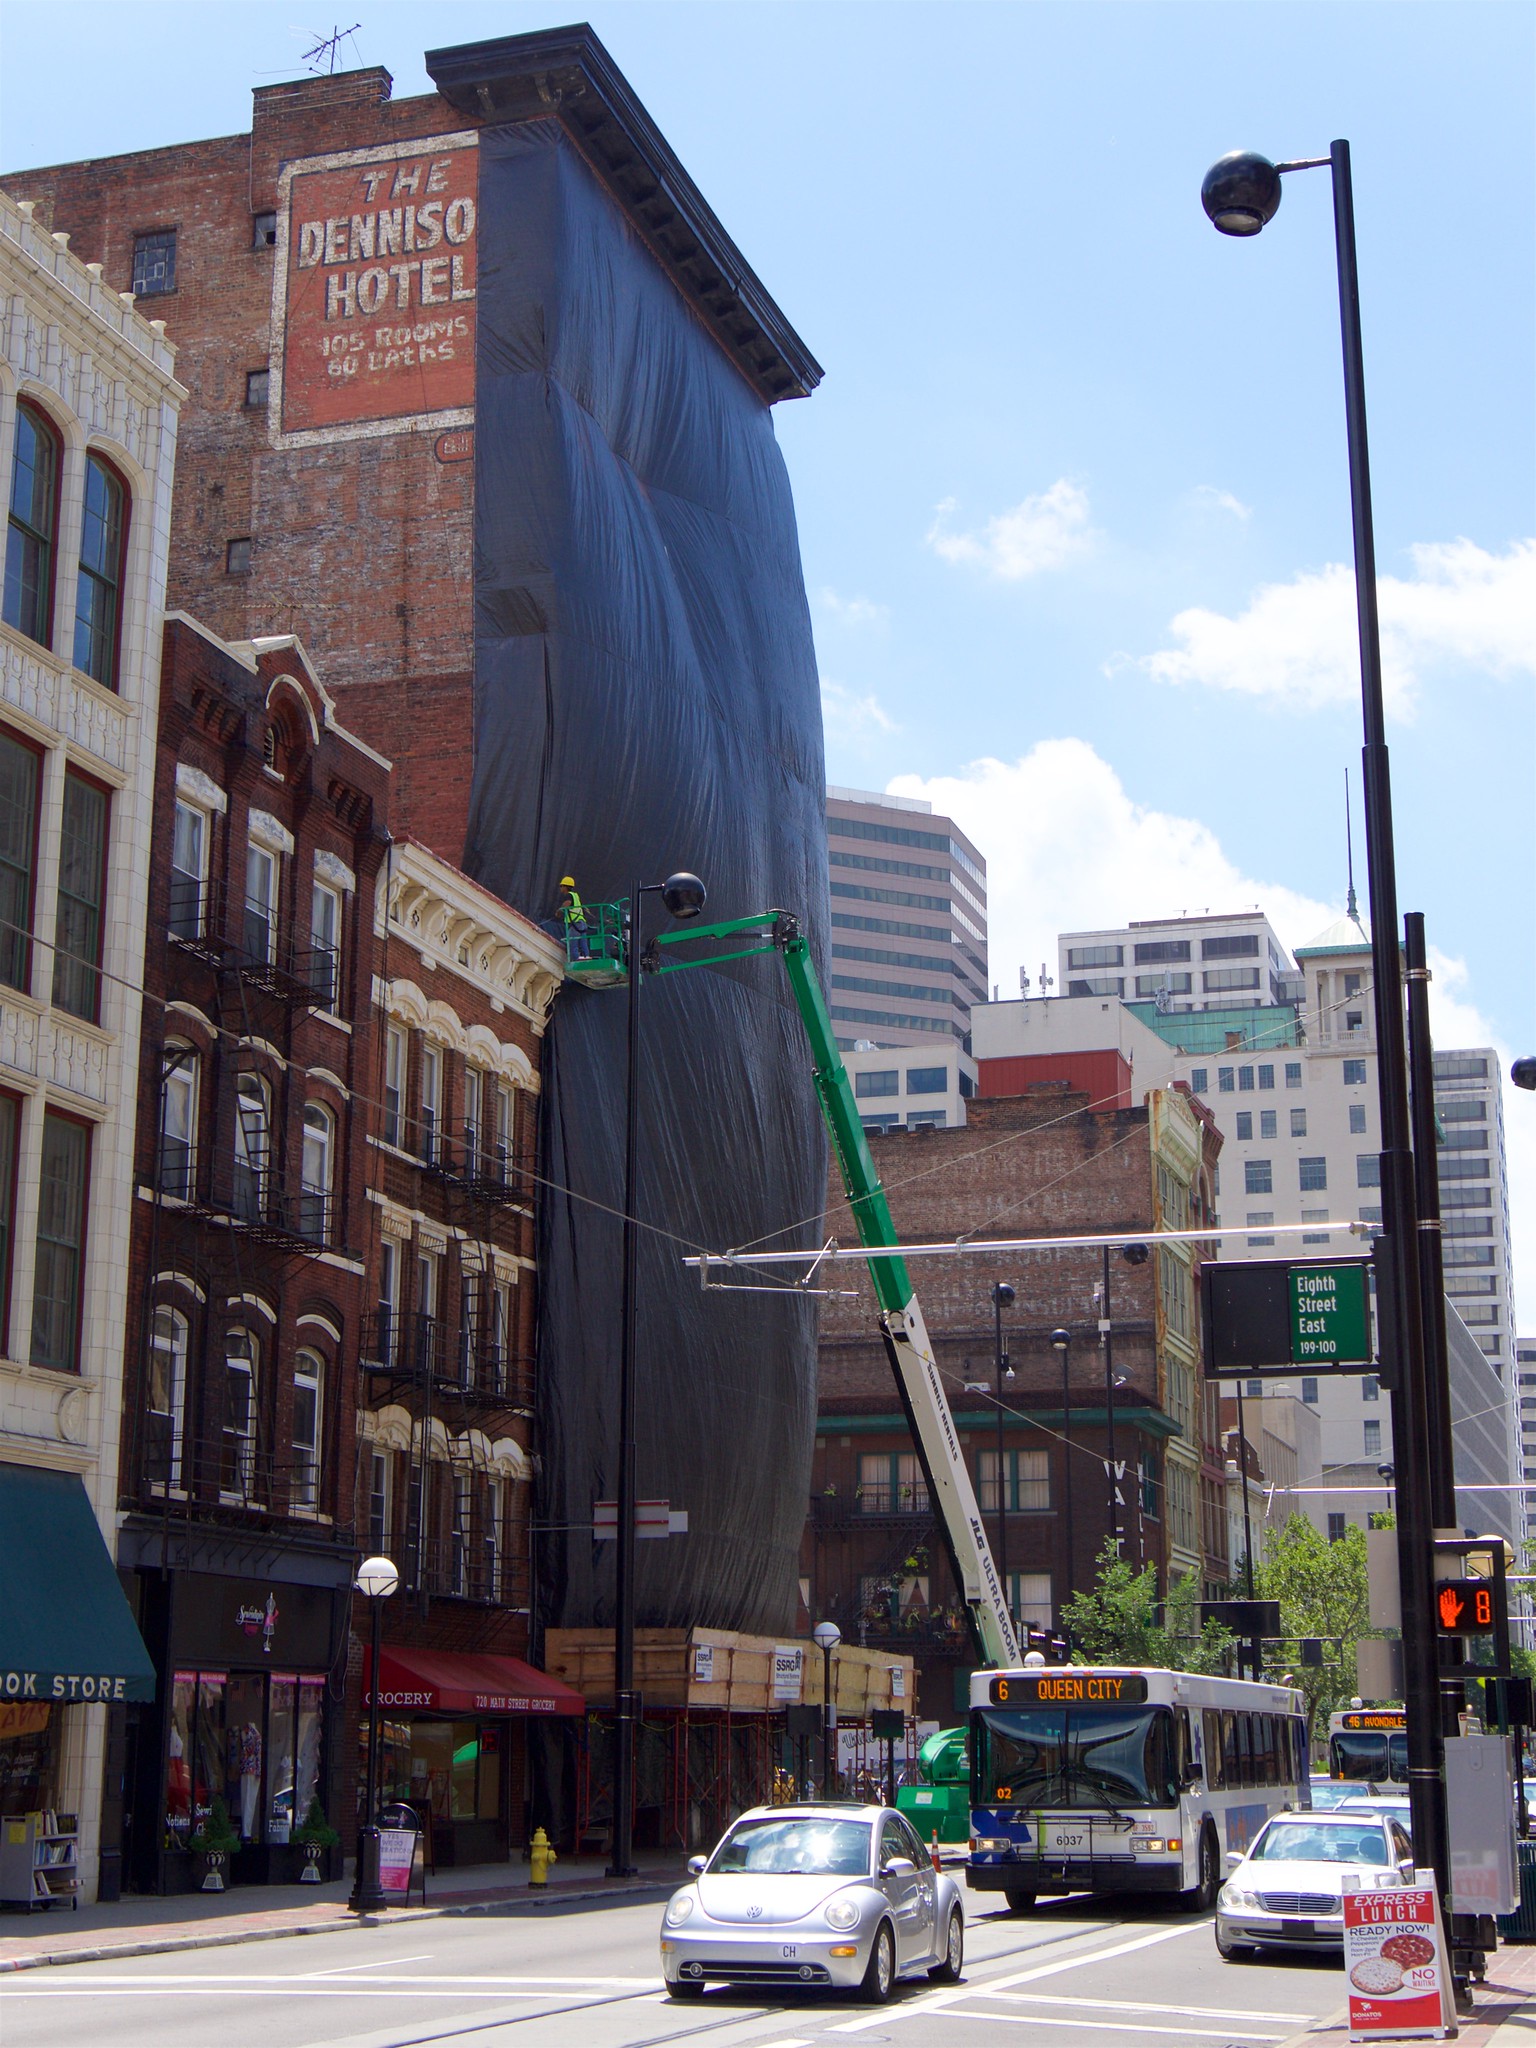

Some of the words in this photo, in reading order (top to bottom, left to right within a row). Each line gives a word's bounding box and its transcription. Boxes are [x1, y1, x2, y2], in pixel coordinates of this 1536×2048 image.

[361, 158, 452, 203] THE
[325, 255, 477, 321] HOTEL
[319, 331, 365, 356] 105
[375, 315, 469, 348] ROOMS
[1297, 1275, 1336, 1296] Eighth
[1298, 1296, 1337, 1313] Street
[1299, 1317, 1326, 1334] East
[1300, 1340, 1336, 1354] 199-100
[941, 1412, 958, 1461] RENTALS
[970, 1518, 985, 1550] JLG
[983, 1556, 1001, 1609] ULTRA
[998, 1610, 1017, 1661] BOOM
[776, 1659, 795, 1671] SSRG
[0, 1672, 37, 1696] OK
[52, 1675, 126, 1699] STORE
[998, 1680, 1009, 1700] 6
[1038, 1680, 1083, 1700] QUEEN
[1087, 1679, 1123, 1700] CITY
[475, 1695, 488, 1708] 720
[489, 1696, 506, 1709] MAIN
[508, 1697, 530, 1710] STREET
[531, 1699, 556, 1711] GROCERY
[1348, 1715, 1361, 1728] 46
[996, 1787, 1012, 1800] 02
[1056, 1835, 1083, 1846] 6037
[1353, 1892, 1426, 1907] EXPRESS
[1360, 1904, 1417, 1922] LUNCH
[1349, 1926, 1392, 1936] READY
[1395, 1924, 1430, 1934] NOW!
[782, 1945, 796, 1958] CH
[1411, 1968, 1436, 1980] NO
